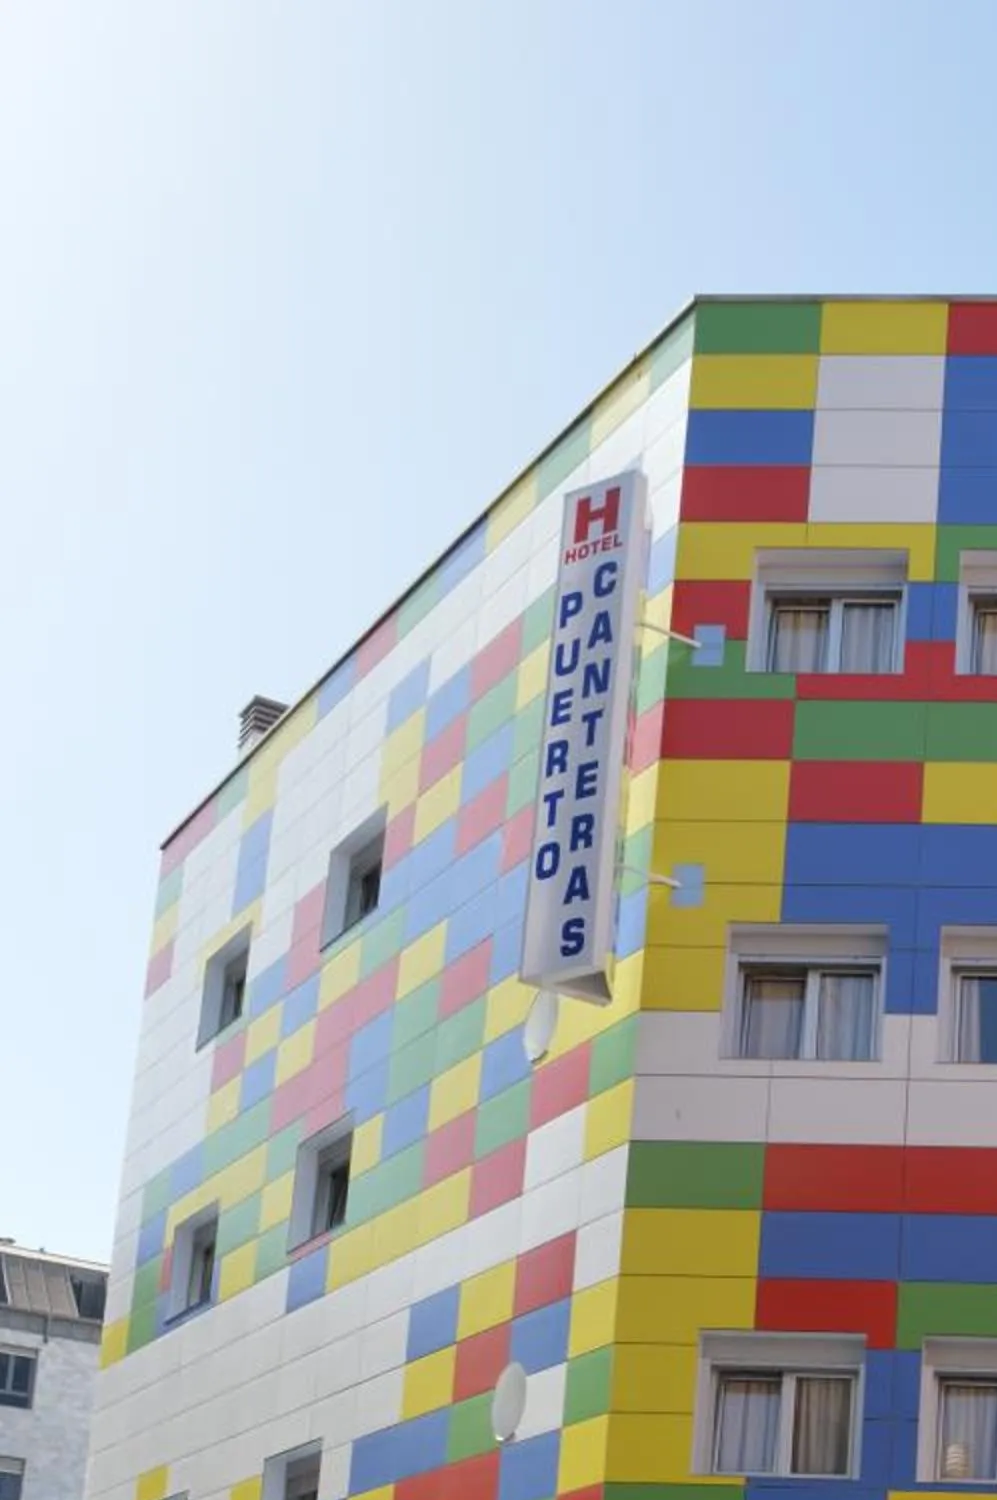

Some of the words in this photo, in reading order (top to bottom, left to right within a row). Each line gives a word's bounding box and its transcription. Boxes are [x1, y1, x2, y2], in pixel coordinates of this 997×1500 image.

[564, 533, 623, 566] HOTEL
[573, 486, 621, 545] H
[535, 591, 583, 881] PUERTO
[560, 561, 618, 958] CANTERAS
